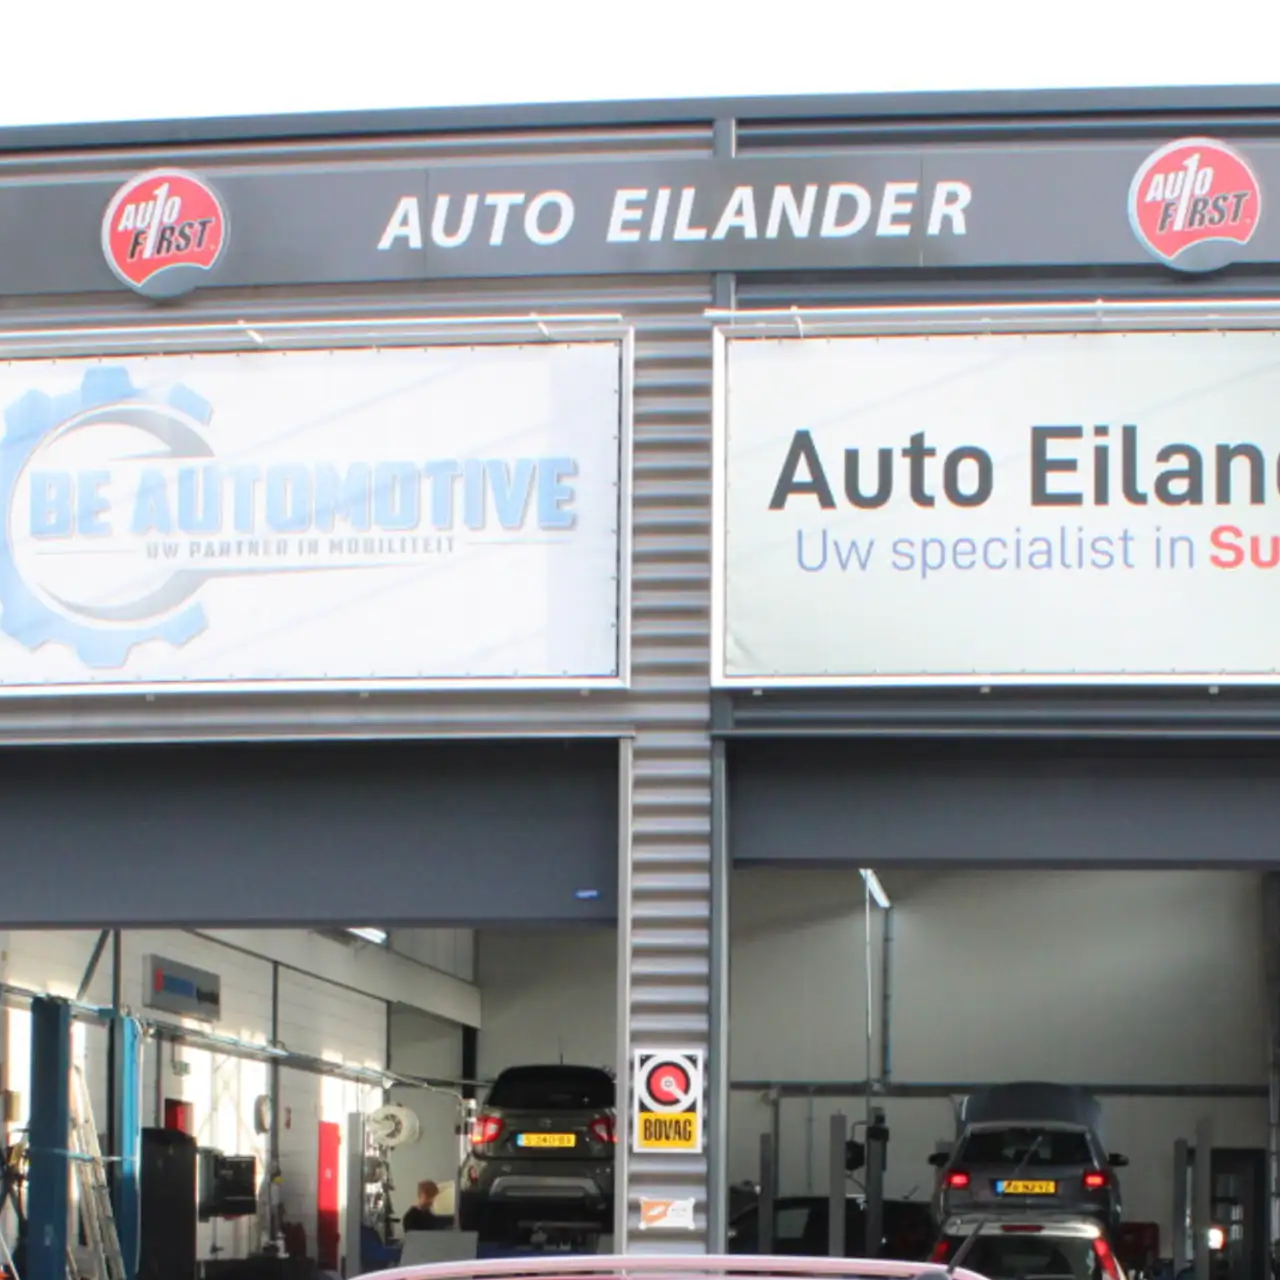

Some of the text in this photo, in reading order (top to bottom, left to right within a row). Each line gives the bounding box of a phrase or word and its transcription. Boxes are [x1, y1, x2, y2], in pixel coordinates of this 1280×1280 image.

[1144, 153, 1214, 203] AUTO
[117, 182, 182, 232] AUTO
[378, 181, 972, 250] AUTO EILANDER
[1156, 190, 1253, 236] FIRST
[126, 216, 216, 263] FIRST
[768, 429, 993, 510] Auto
[29, 457, 578, 541] BE AUTOMOTIVE
[146, 535, 455, 559] UW PARTNER IN MOBILITEIT
[797, 529, 874, 571] Uw
[892, 526, 1135, 579] specialist
[1155, 525, 1194, 568] in
[643, 1117, 692, 1142] BOVAG
